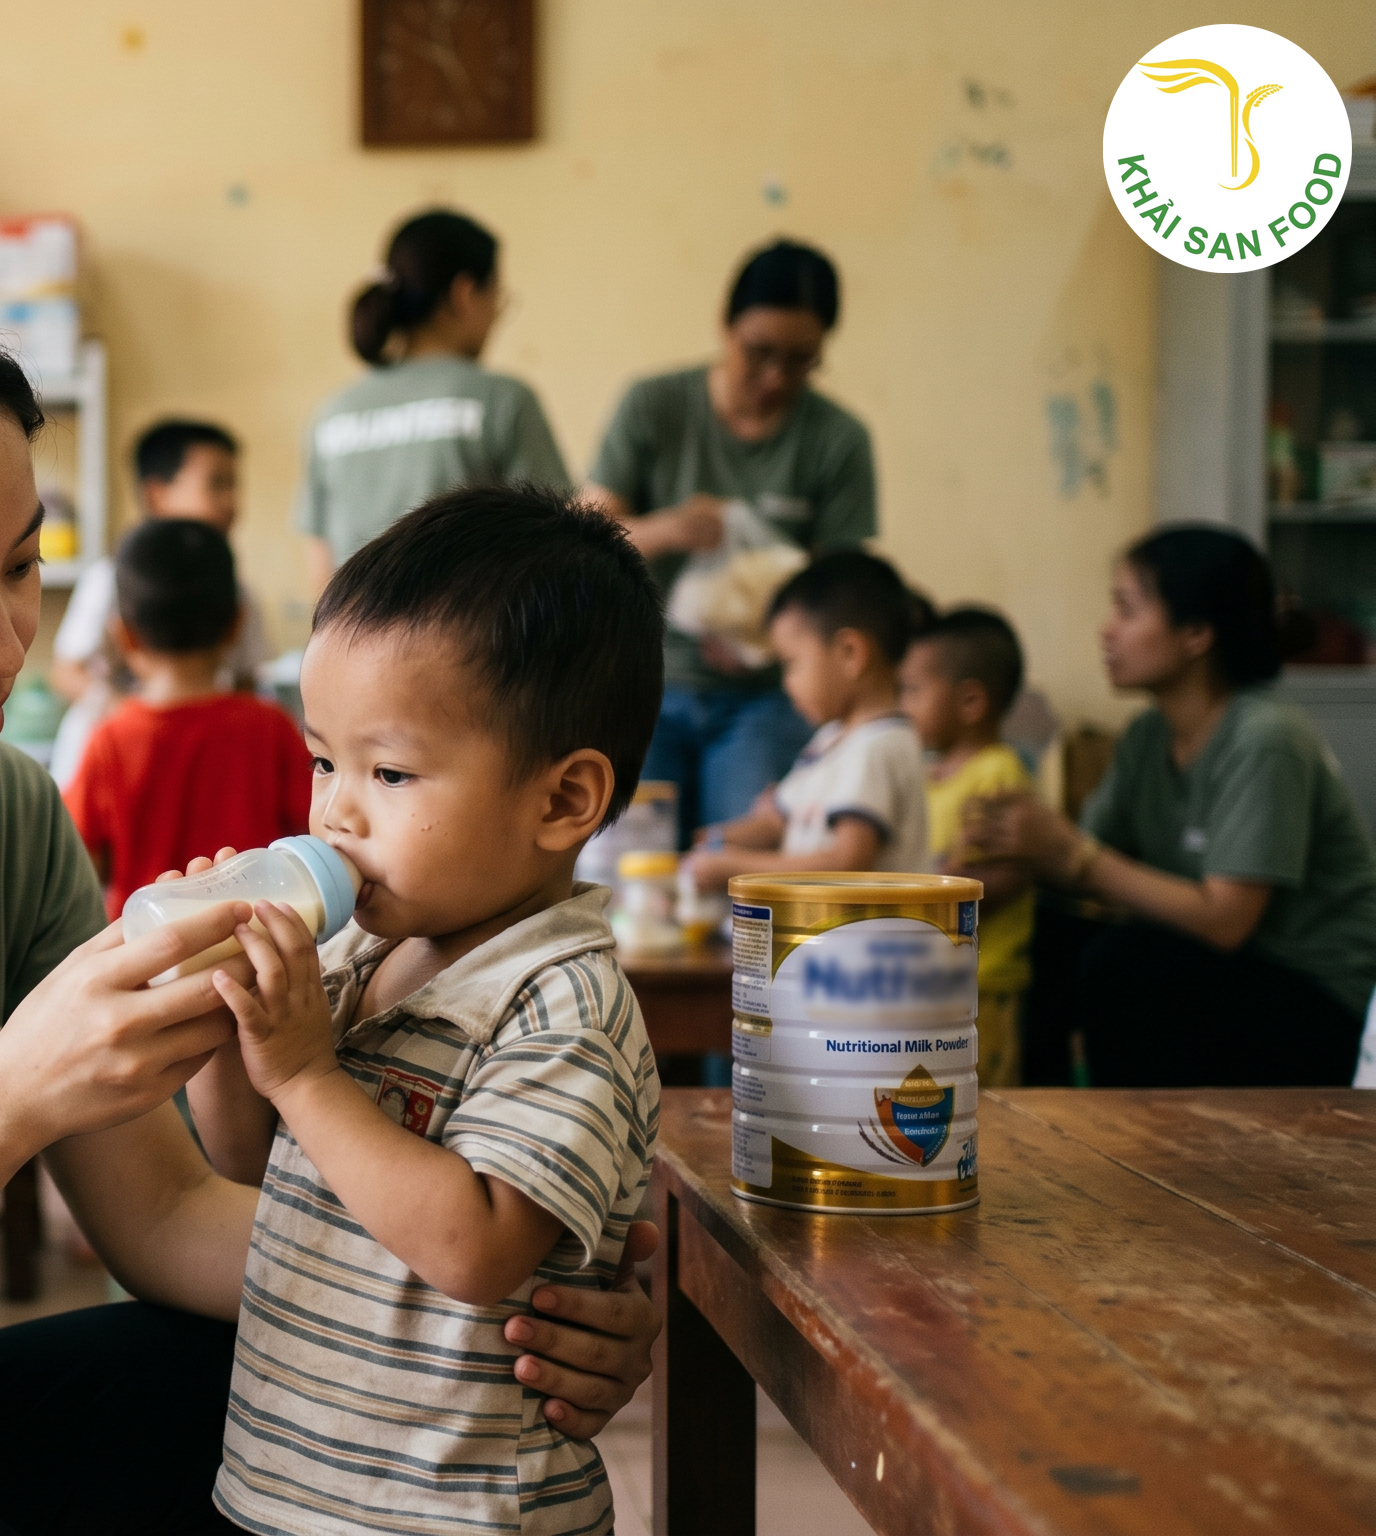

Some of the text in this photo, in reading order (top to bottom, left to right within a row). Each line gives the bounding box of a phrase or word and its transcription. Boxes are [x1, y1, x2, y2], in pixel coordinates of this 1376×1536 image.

[826, 1036, 969, 1053] Nutritional Milk Powder
